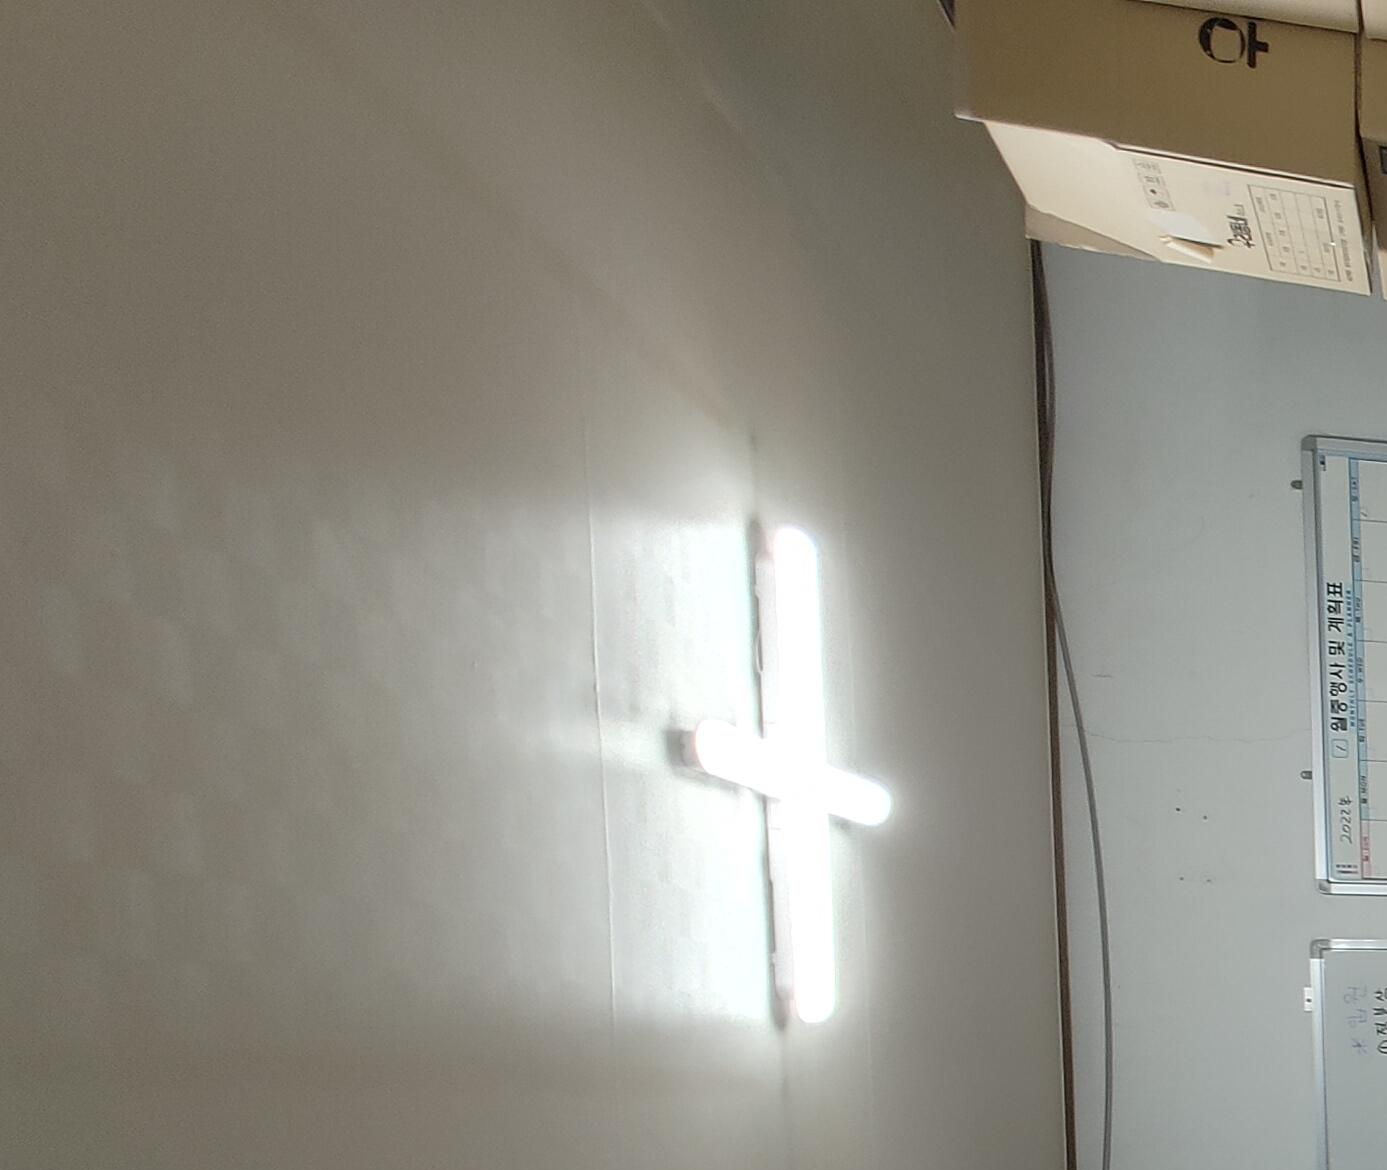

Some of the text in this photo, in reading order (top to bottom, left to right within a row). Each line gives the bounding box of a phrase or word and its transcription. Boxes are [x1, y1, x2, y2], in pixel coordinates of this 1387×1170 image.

[1326, 582, 1348, 732] 월중행사 및 계획표
